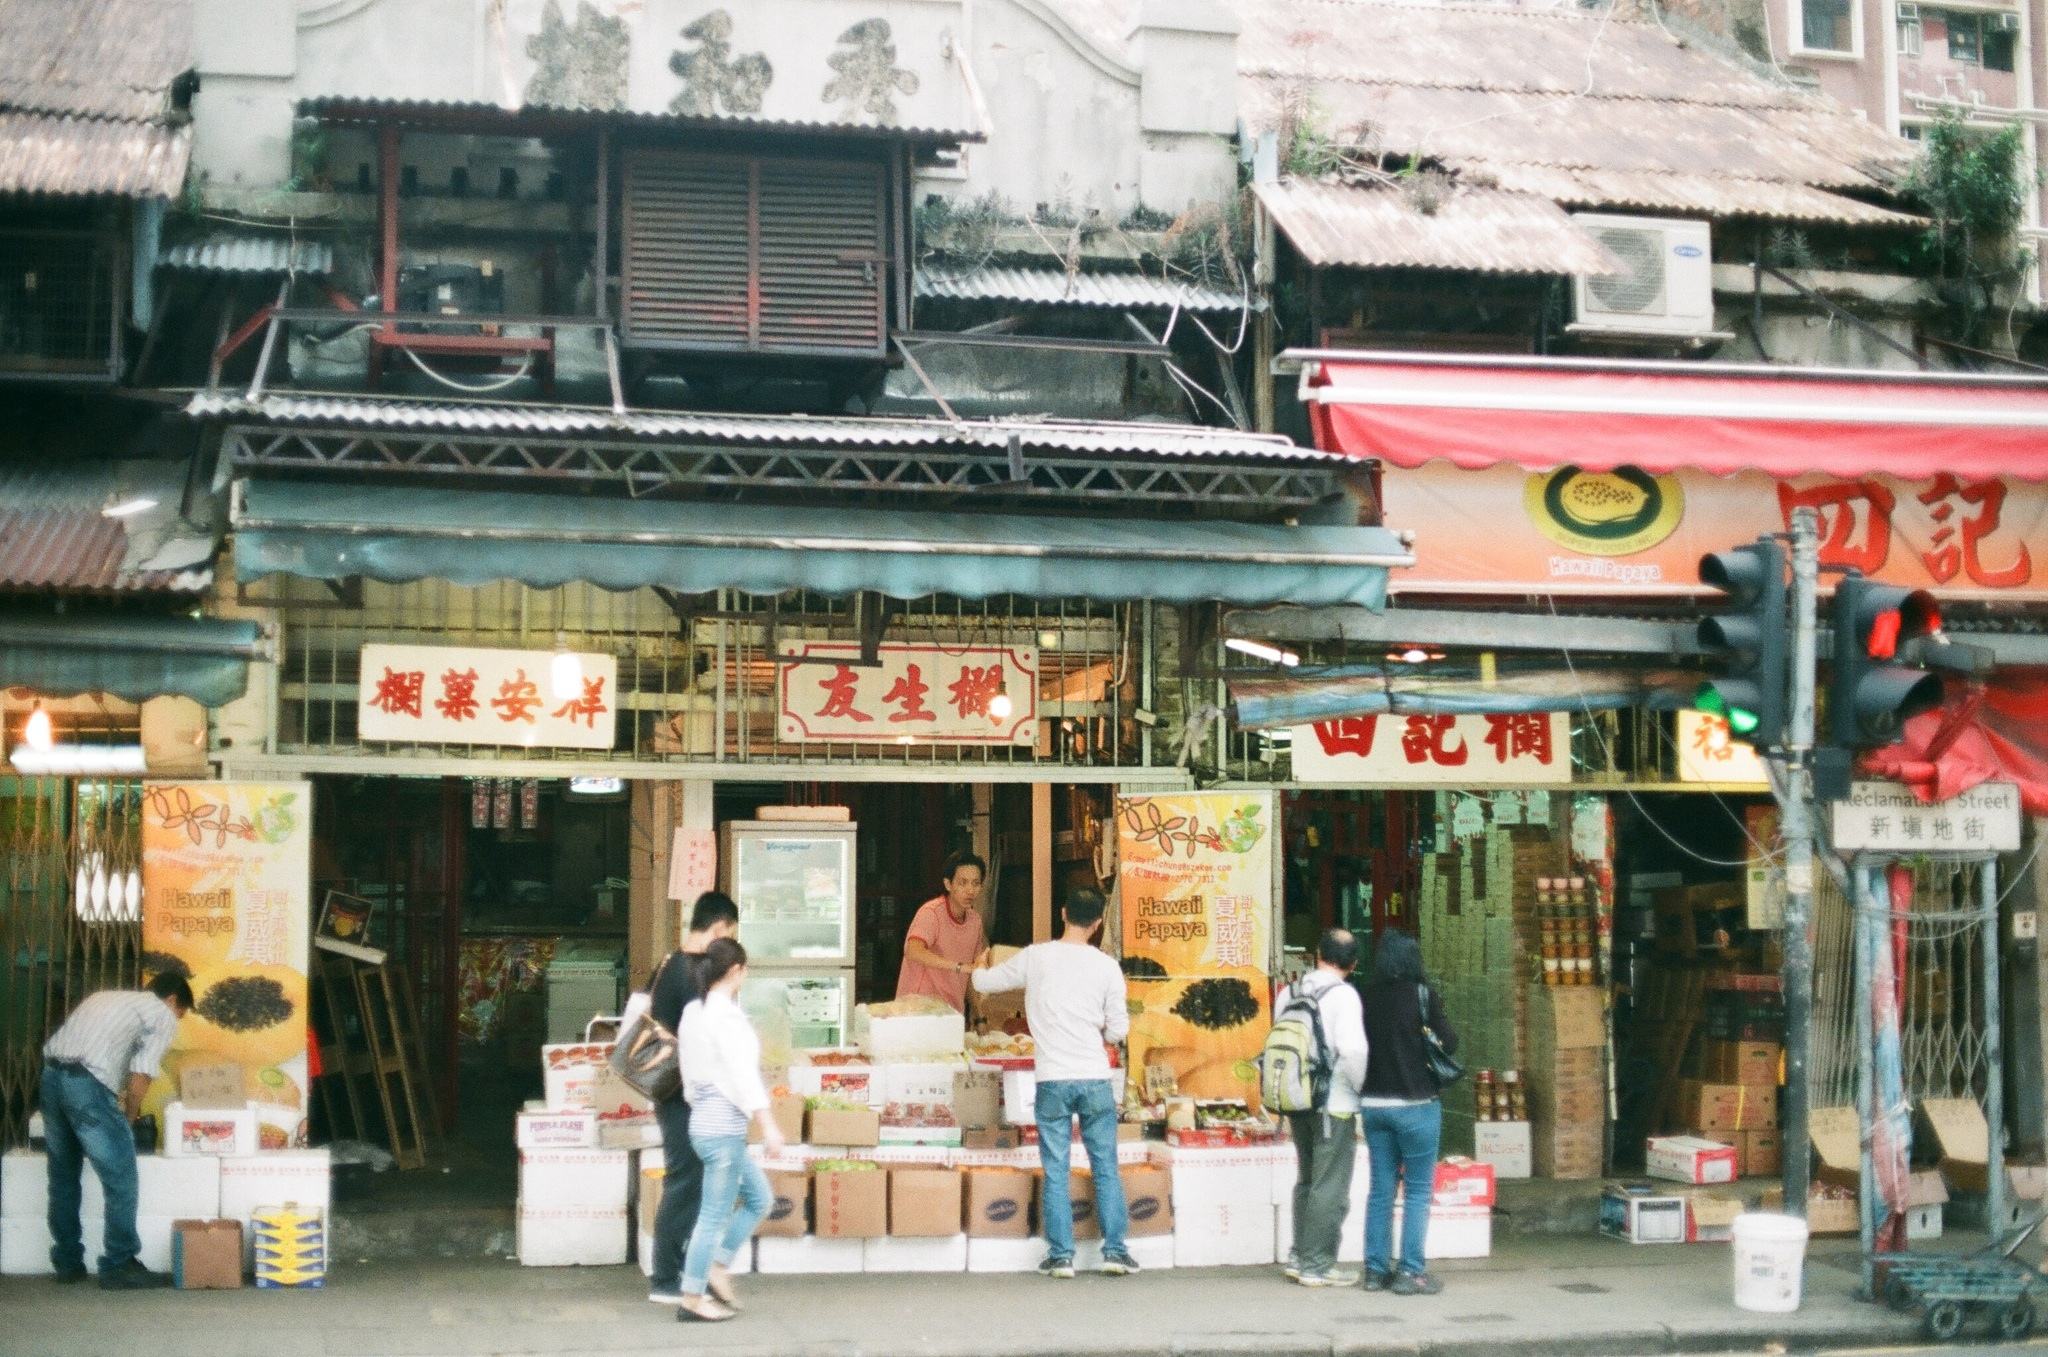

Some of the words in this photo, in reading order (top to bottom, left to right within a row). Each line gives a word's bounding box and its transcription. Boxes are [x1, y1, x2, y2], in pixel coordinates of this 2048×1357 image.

[1958, 793, 2011, 810] Street
[161, 887, 232, 909] Hawaii
[1138, 895, 1203, 917] Hawaii
[157, 912, 235, 938] Papaya
[1135, 919, 1208, 942] Papaya
[1215, 894, 1239, 968] 夏威夷
